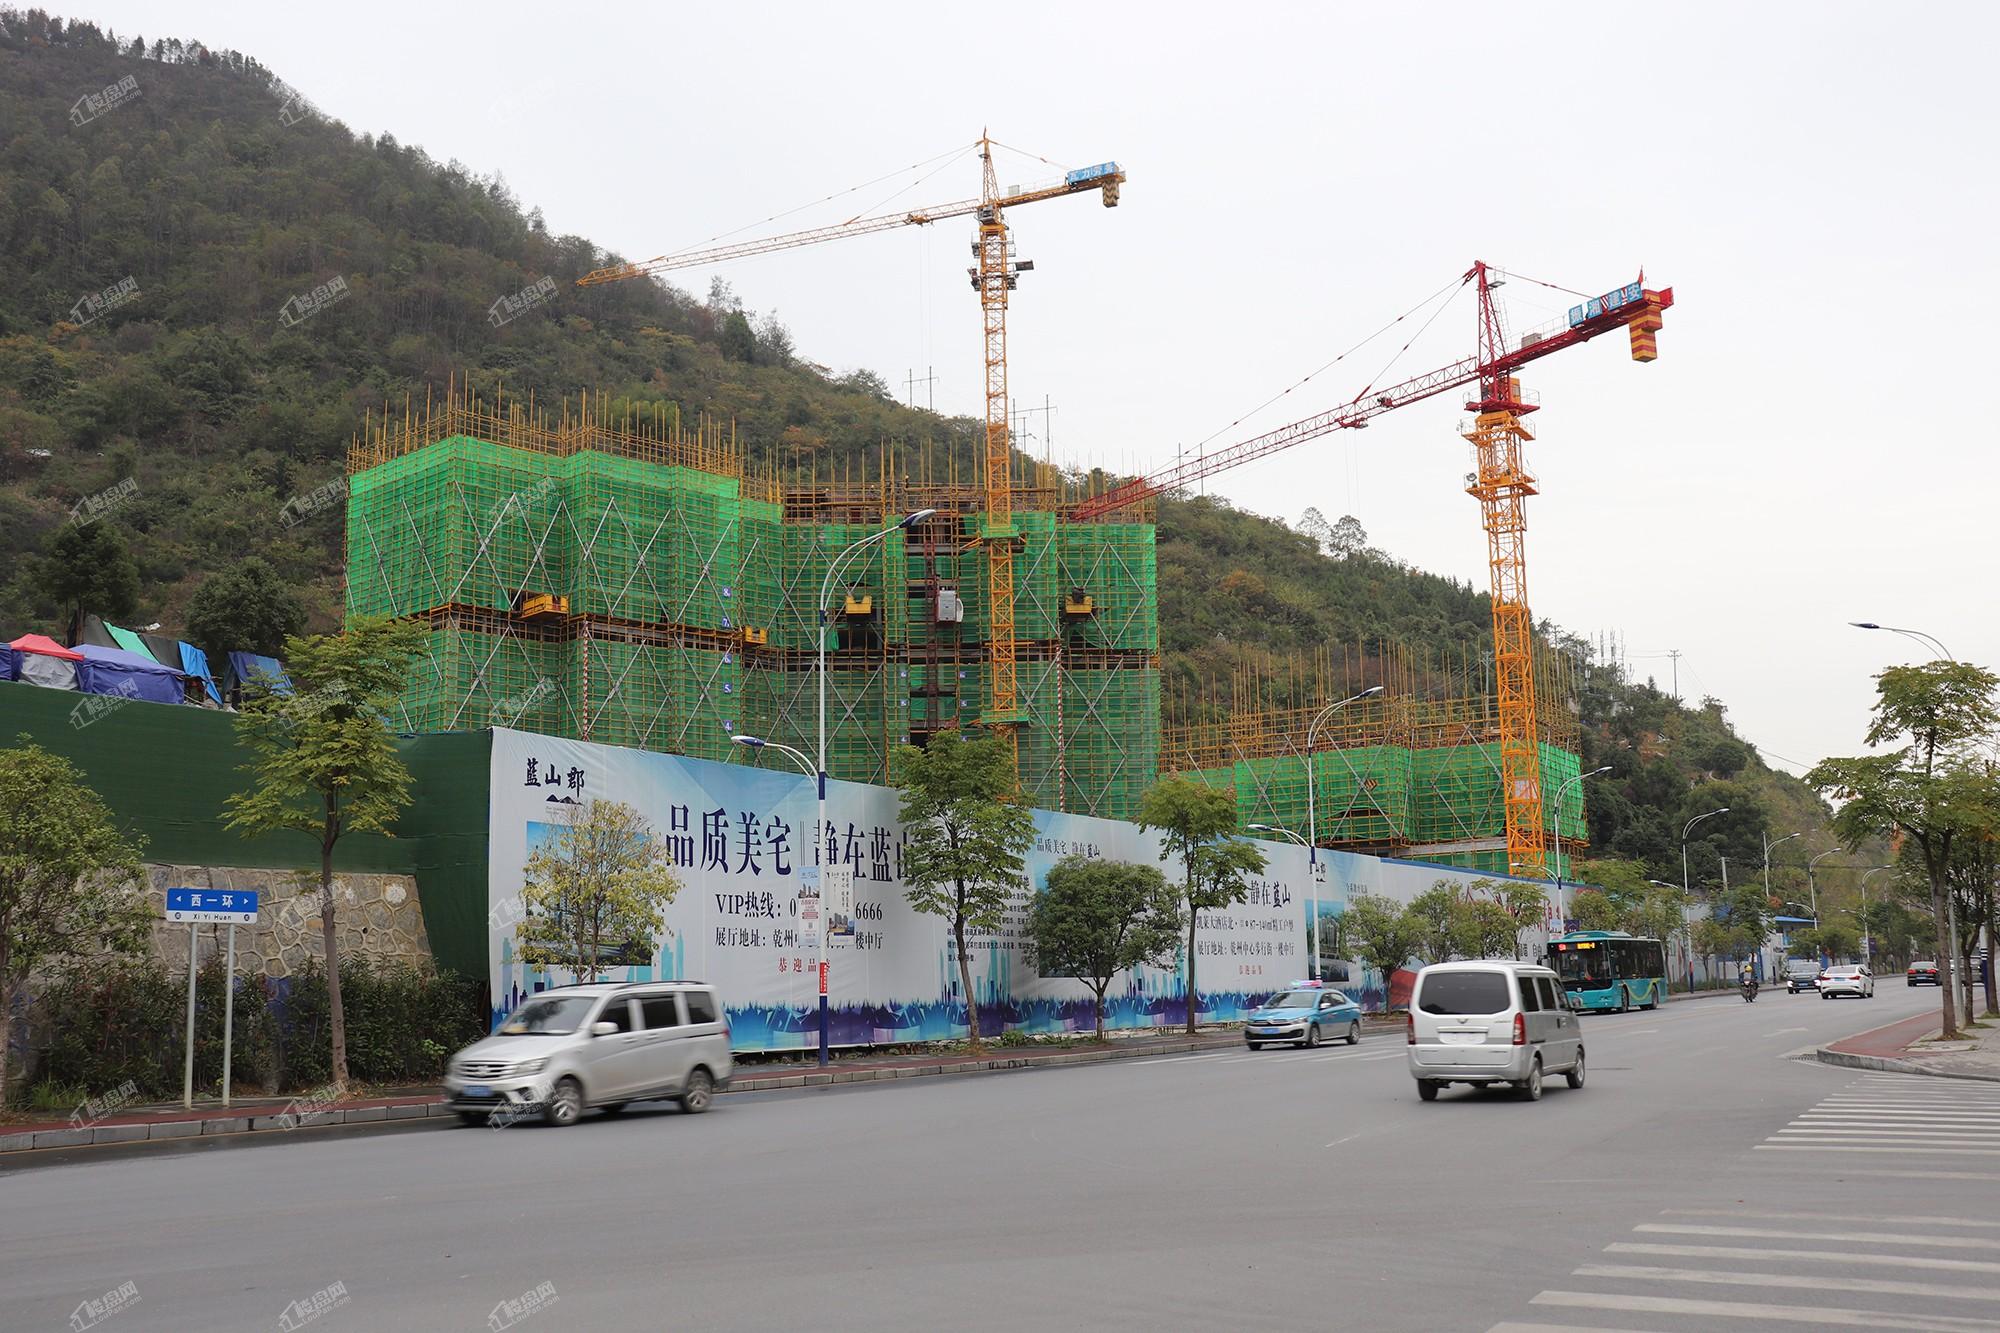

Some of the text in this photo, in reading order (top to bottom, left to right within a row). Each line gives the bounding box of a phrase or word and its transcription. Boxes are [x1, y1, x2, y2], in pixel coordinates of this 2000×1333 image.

[666, 803, 792, 876] 品质美宅
[191, 893, 234, 909] 西一环
